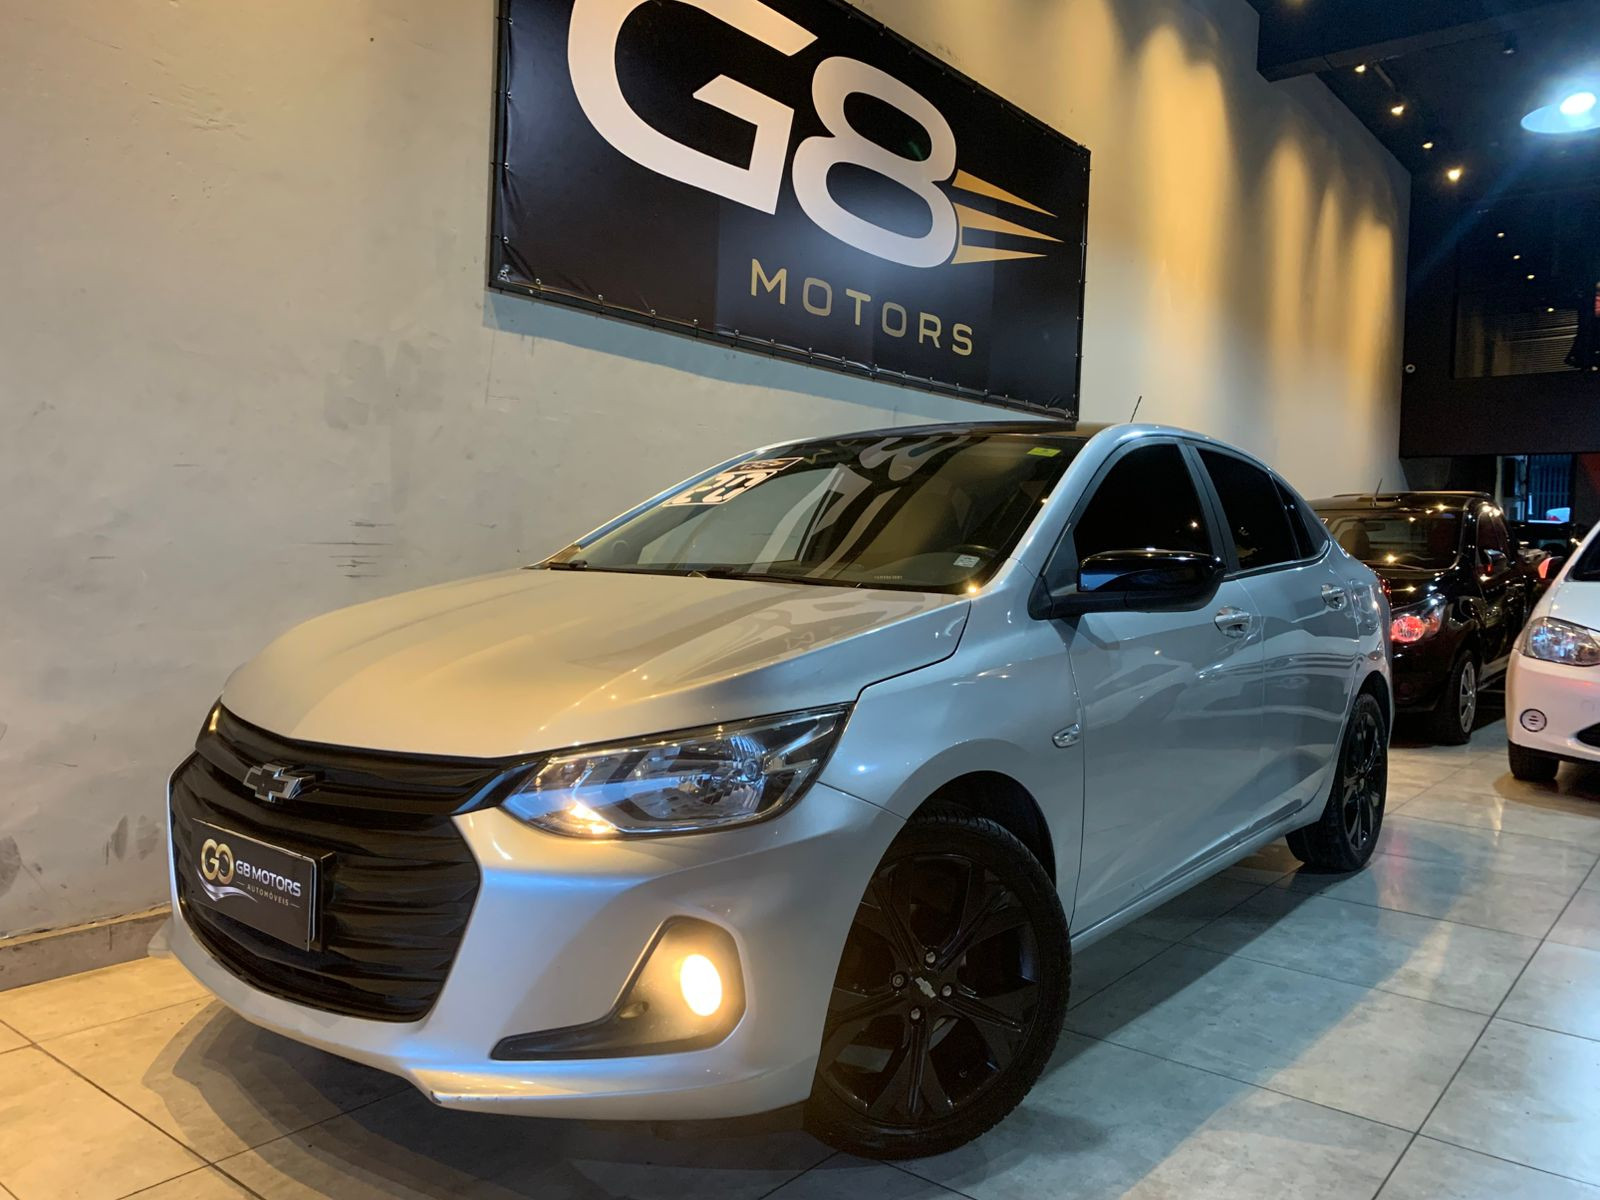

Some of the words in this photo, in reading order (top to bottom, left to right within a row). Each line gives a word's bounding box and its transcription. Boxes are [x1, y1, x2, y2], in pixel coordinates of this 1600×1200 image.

[568, 0, 957, 268] G8
[750, 258, 973, 356] MOTORS
[252, 866, 301, 897] MOTORS
